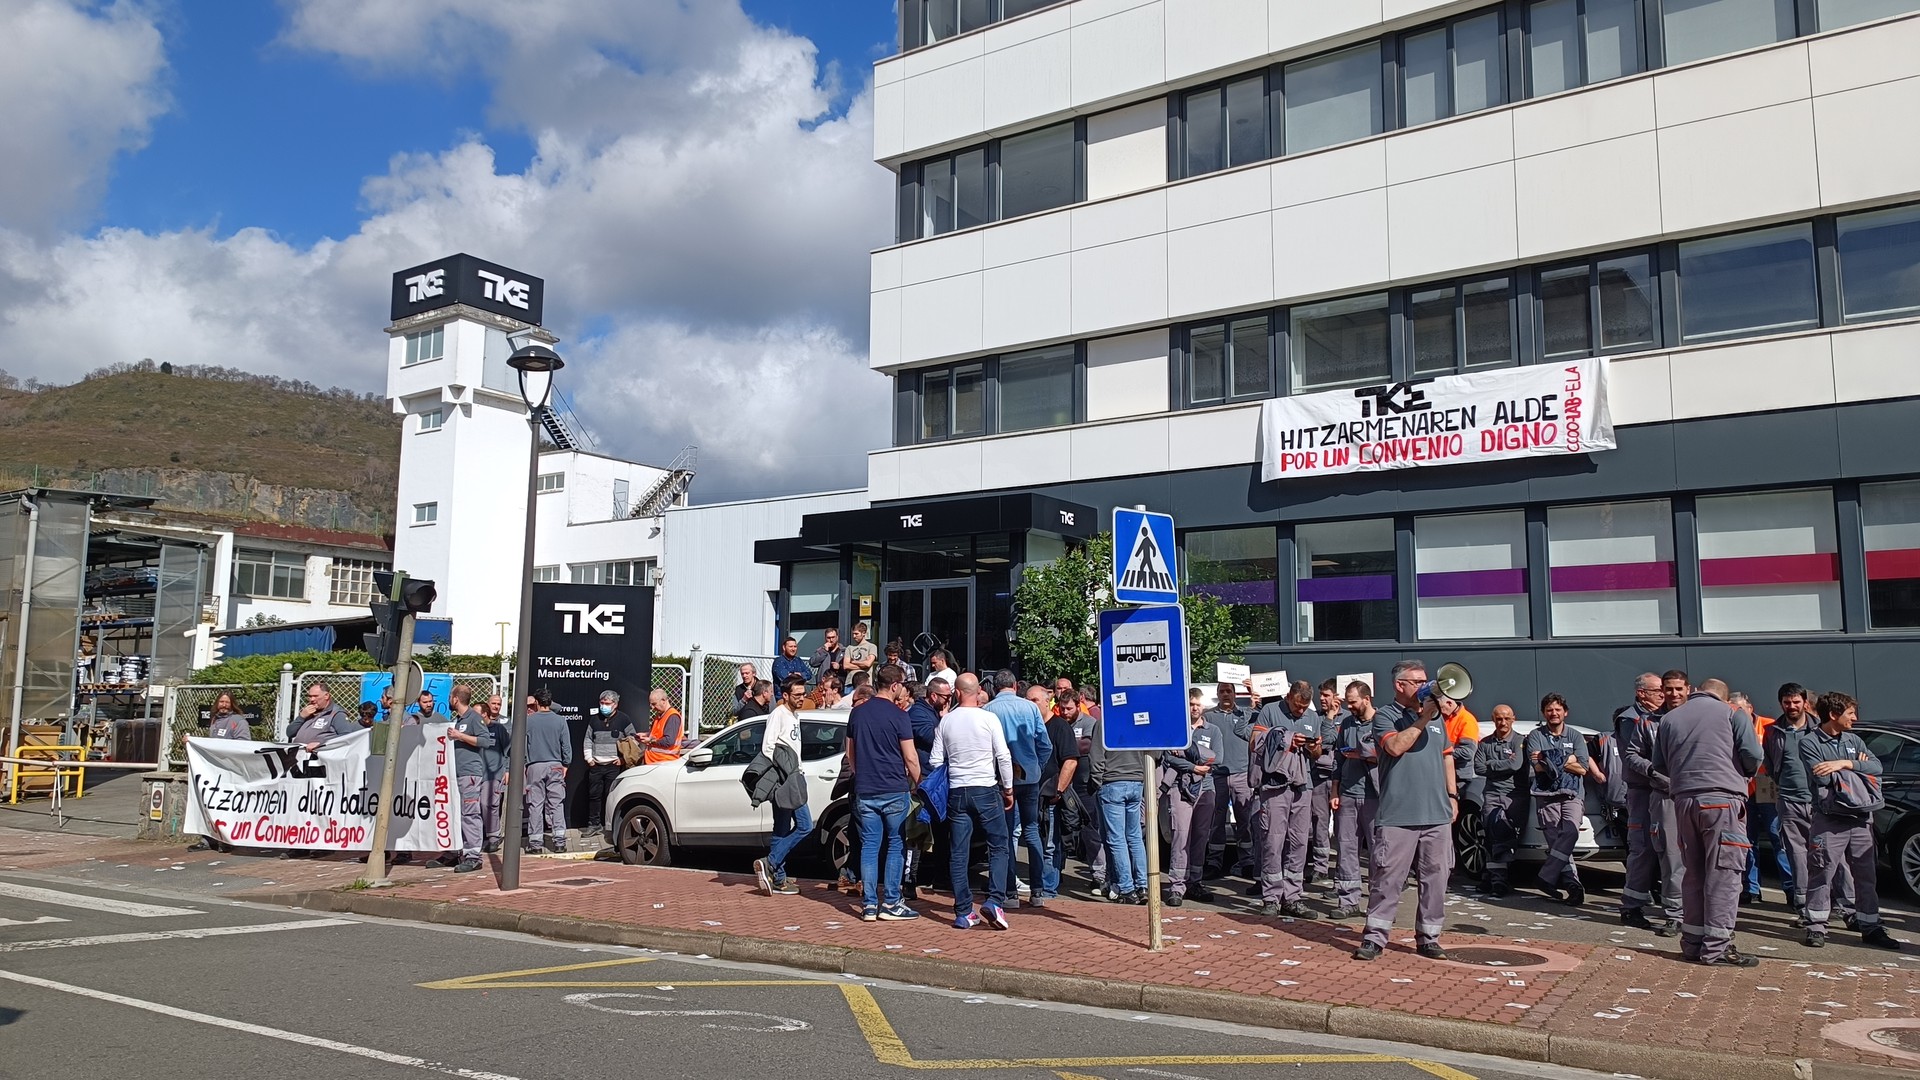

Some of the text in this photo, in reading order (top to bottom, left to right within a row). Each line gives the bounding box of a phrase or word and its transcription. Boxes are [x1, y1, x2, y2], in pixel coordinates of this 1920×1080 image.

[405, 269, 445, 303] TKE
[477, 269, 530, 310] TKE
[1354, 378, 1435, 418] TKE
[1280, 394, 1559, 450] HITZARMENAREN ALDE
[1281, 422, 1558, 472] POR UN CONVENIO DIGNO
[900, 514, 923, 528] TKE
[1059, 510, 1075, 526] TKE
[554, 602, 626, 635] TKE
[537, 656, 596, 667] TK Elevator
[537, 669, 610, 681] Manufacturing
[340, 771, 379, 816] bate
[393, 777, 431, 820] alde
[230, 821, 252, 840] un
[255, 815, 320, 845] Convenio
[324, 818, 365, 848] digno
